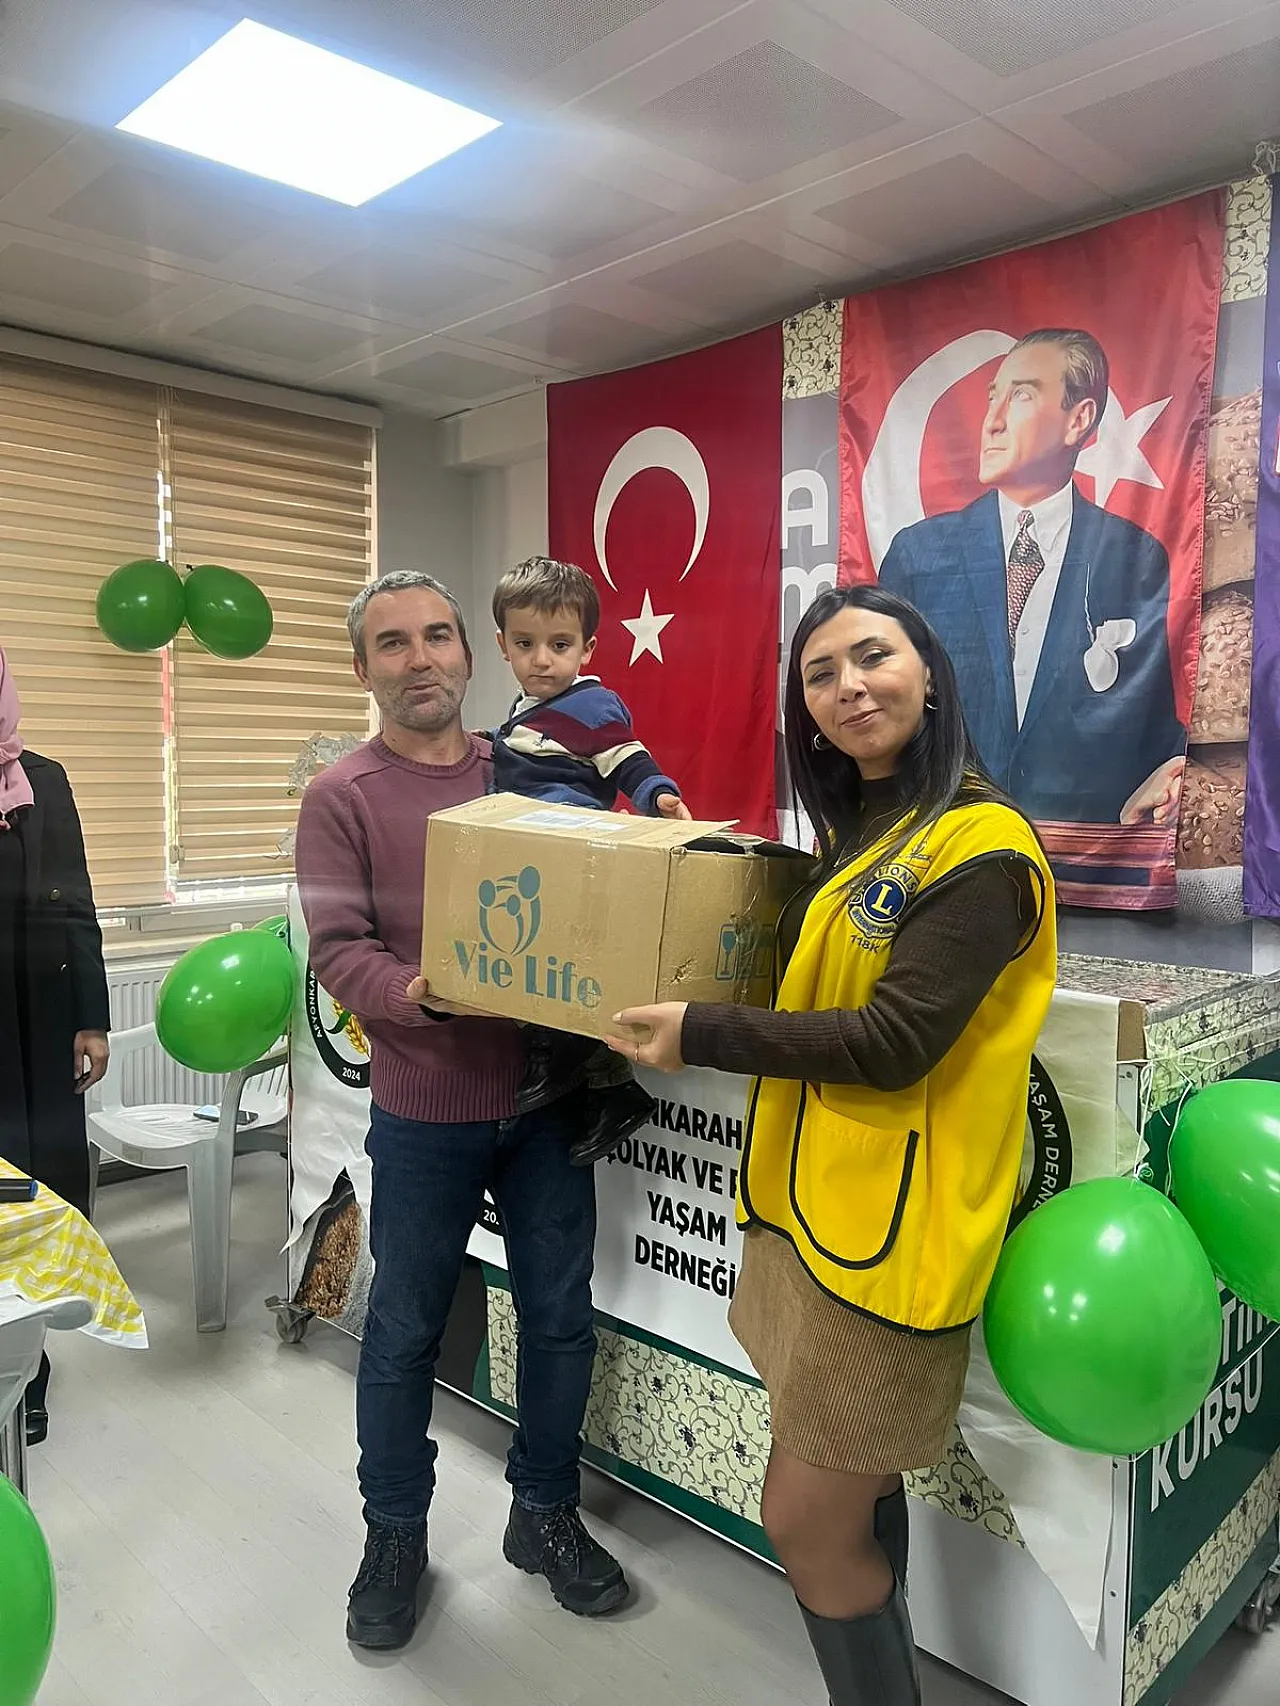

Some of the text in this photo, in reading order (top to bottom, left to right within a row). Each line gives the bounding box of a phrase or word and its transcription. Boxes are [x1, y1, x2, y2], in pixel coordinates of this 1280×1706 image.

[871, 883, 893, 916] L
[454, 940, 602, 1008] Vie Life
[342, 1067, 361, 1081] 2024
[1029, 1073, 1059, 1138] AŞAM
[691, 1156, 723, 1195] VE
[483, 1209, 500, 1226] 20
[647, 1190, 727, 1246] YAŞAM
[635, 1233, 736, 1300] DERNEĞİ
[1150, 1346, 1263, 1513] KURSU
